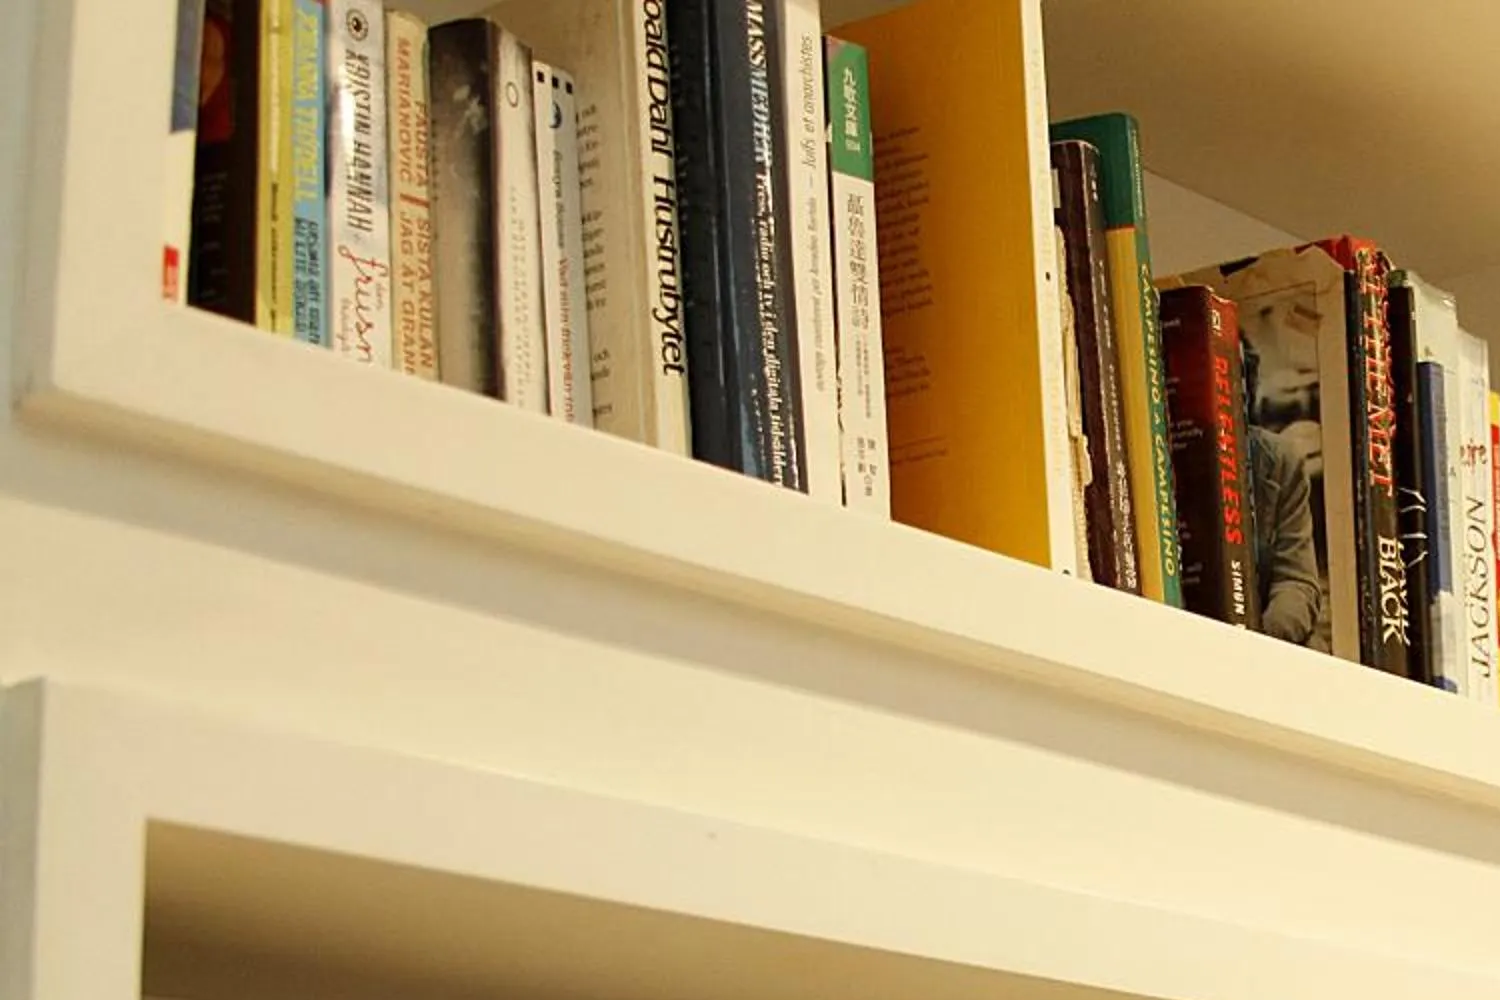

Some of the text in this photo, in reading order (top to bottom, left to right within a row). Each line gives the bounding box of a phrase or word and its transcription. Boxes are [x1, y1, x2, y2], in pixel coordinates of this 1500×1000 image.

[345, 50, 374, 234] KRISTIN HANNAH
[414, 100, 431, 188] FAUSTA
[649, 75, 674, 157] Dahl
[401, 210, 416, 260] JAG
[650, 174, 687, 376] Hustrubytet
[756, 220, 772, 261] radio
[759, 263, 774, 290] och
[402, 266, 418, 294] ÅT
[415, 217, 434, 369] SISTA KULAN
[762, 321, 779, 351] den
[763, 353, 784, 412] digitala
[1140, 262, 1163, 404] CAMPESINO
[1152, 433, 1178, 577] CAMPESINO
[1212, 356, 1243, 546] RELENTLESS
[1230, 559, 1246, 616] SIMON
[1376, 533, 1404, 646] BLACK
[1465, 496, 1492, 679] JACKSON
